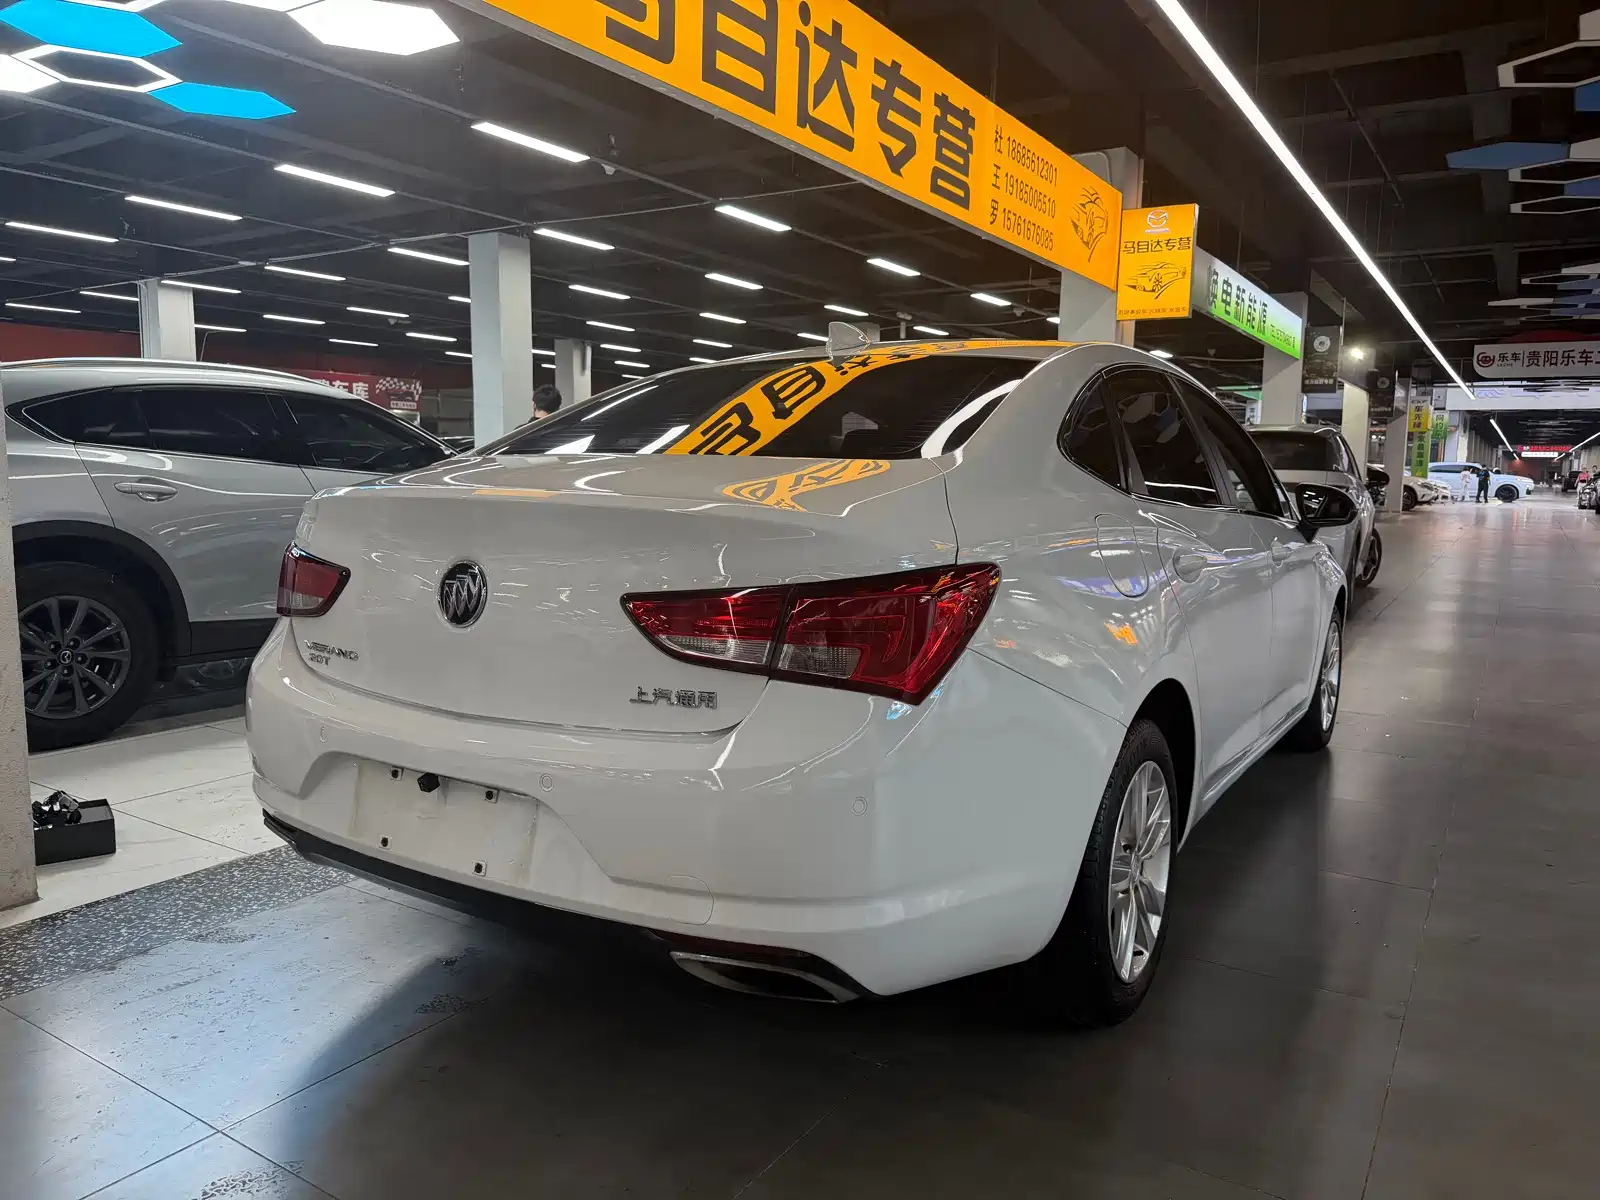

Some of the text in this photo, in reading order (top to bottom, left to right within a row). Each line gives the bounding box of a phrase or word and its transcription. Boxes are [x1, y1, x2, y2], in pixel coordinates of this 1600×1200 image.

[1007, 136, 1058, 187] 18685612301
[992, 163, 1056, 219] 王 19185005510
[989, 199, 1054, 251] 罗 15761676085
[1122, 237, 1192, 255] 马目达专营
[1498, 352, 1520, 363] 乐车
[629, 686, 718, 710] 上汽通用
